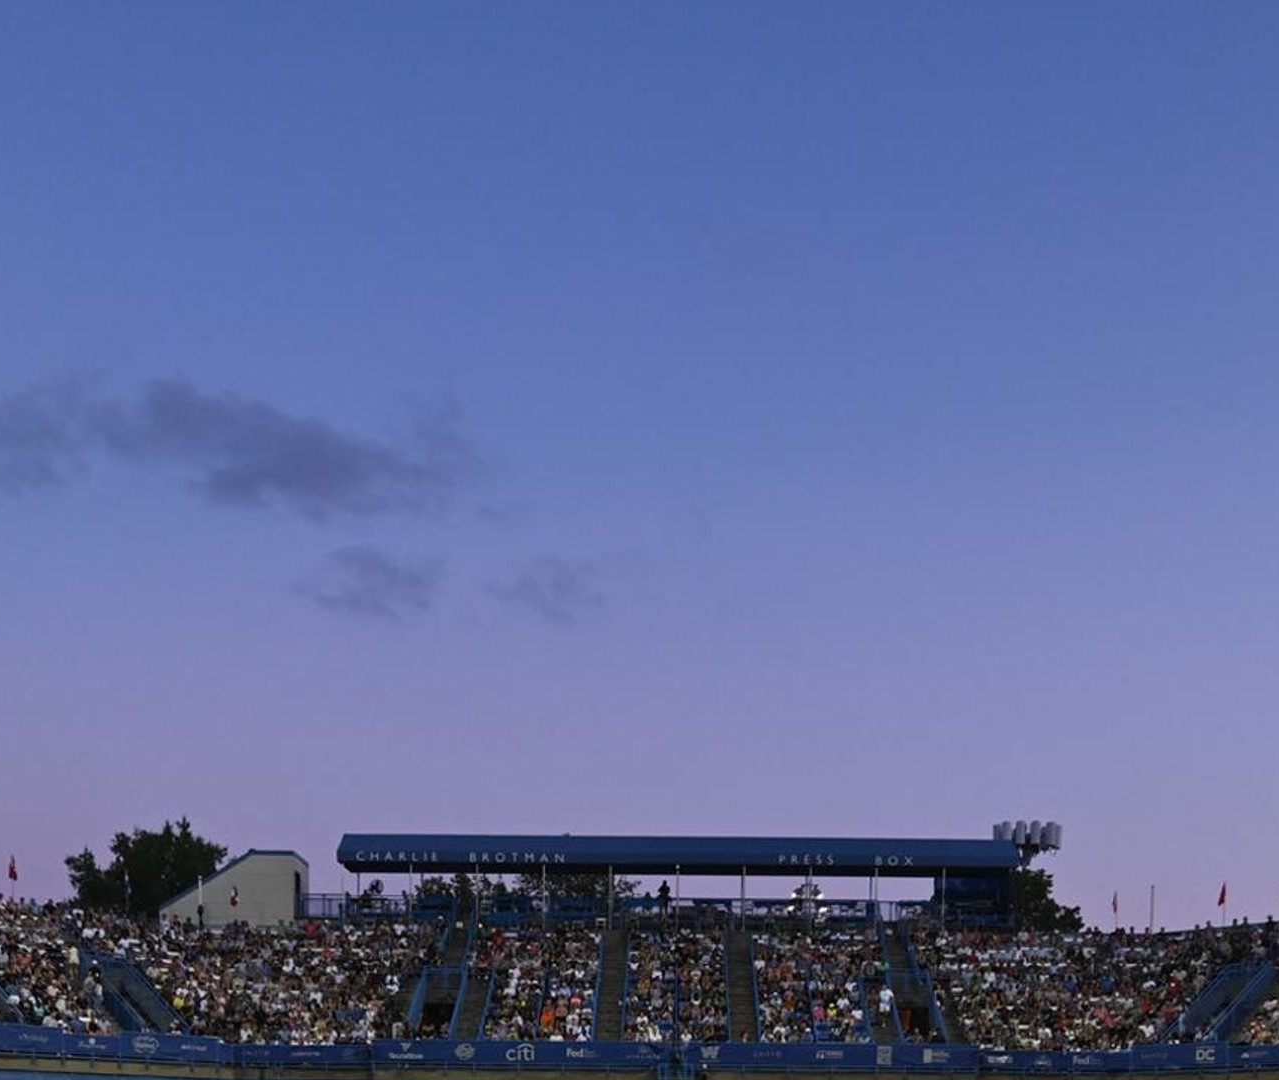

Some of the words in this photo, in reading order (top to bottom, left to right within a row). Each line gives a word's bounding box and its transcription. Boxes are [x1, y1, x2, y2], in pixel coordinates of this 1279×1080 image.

[355, 851, 438, 862] CHARLIE
[469, 852, 566, 863] BROTMAN
[779, 855, 835, 865] PRESS
[874, 856, 914, 866] BOX
[506, 1043, 535, 1062] citi
